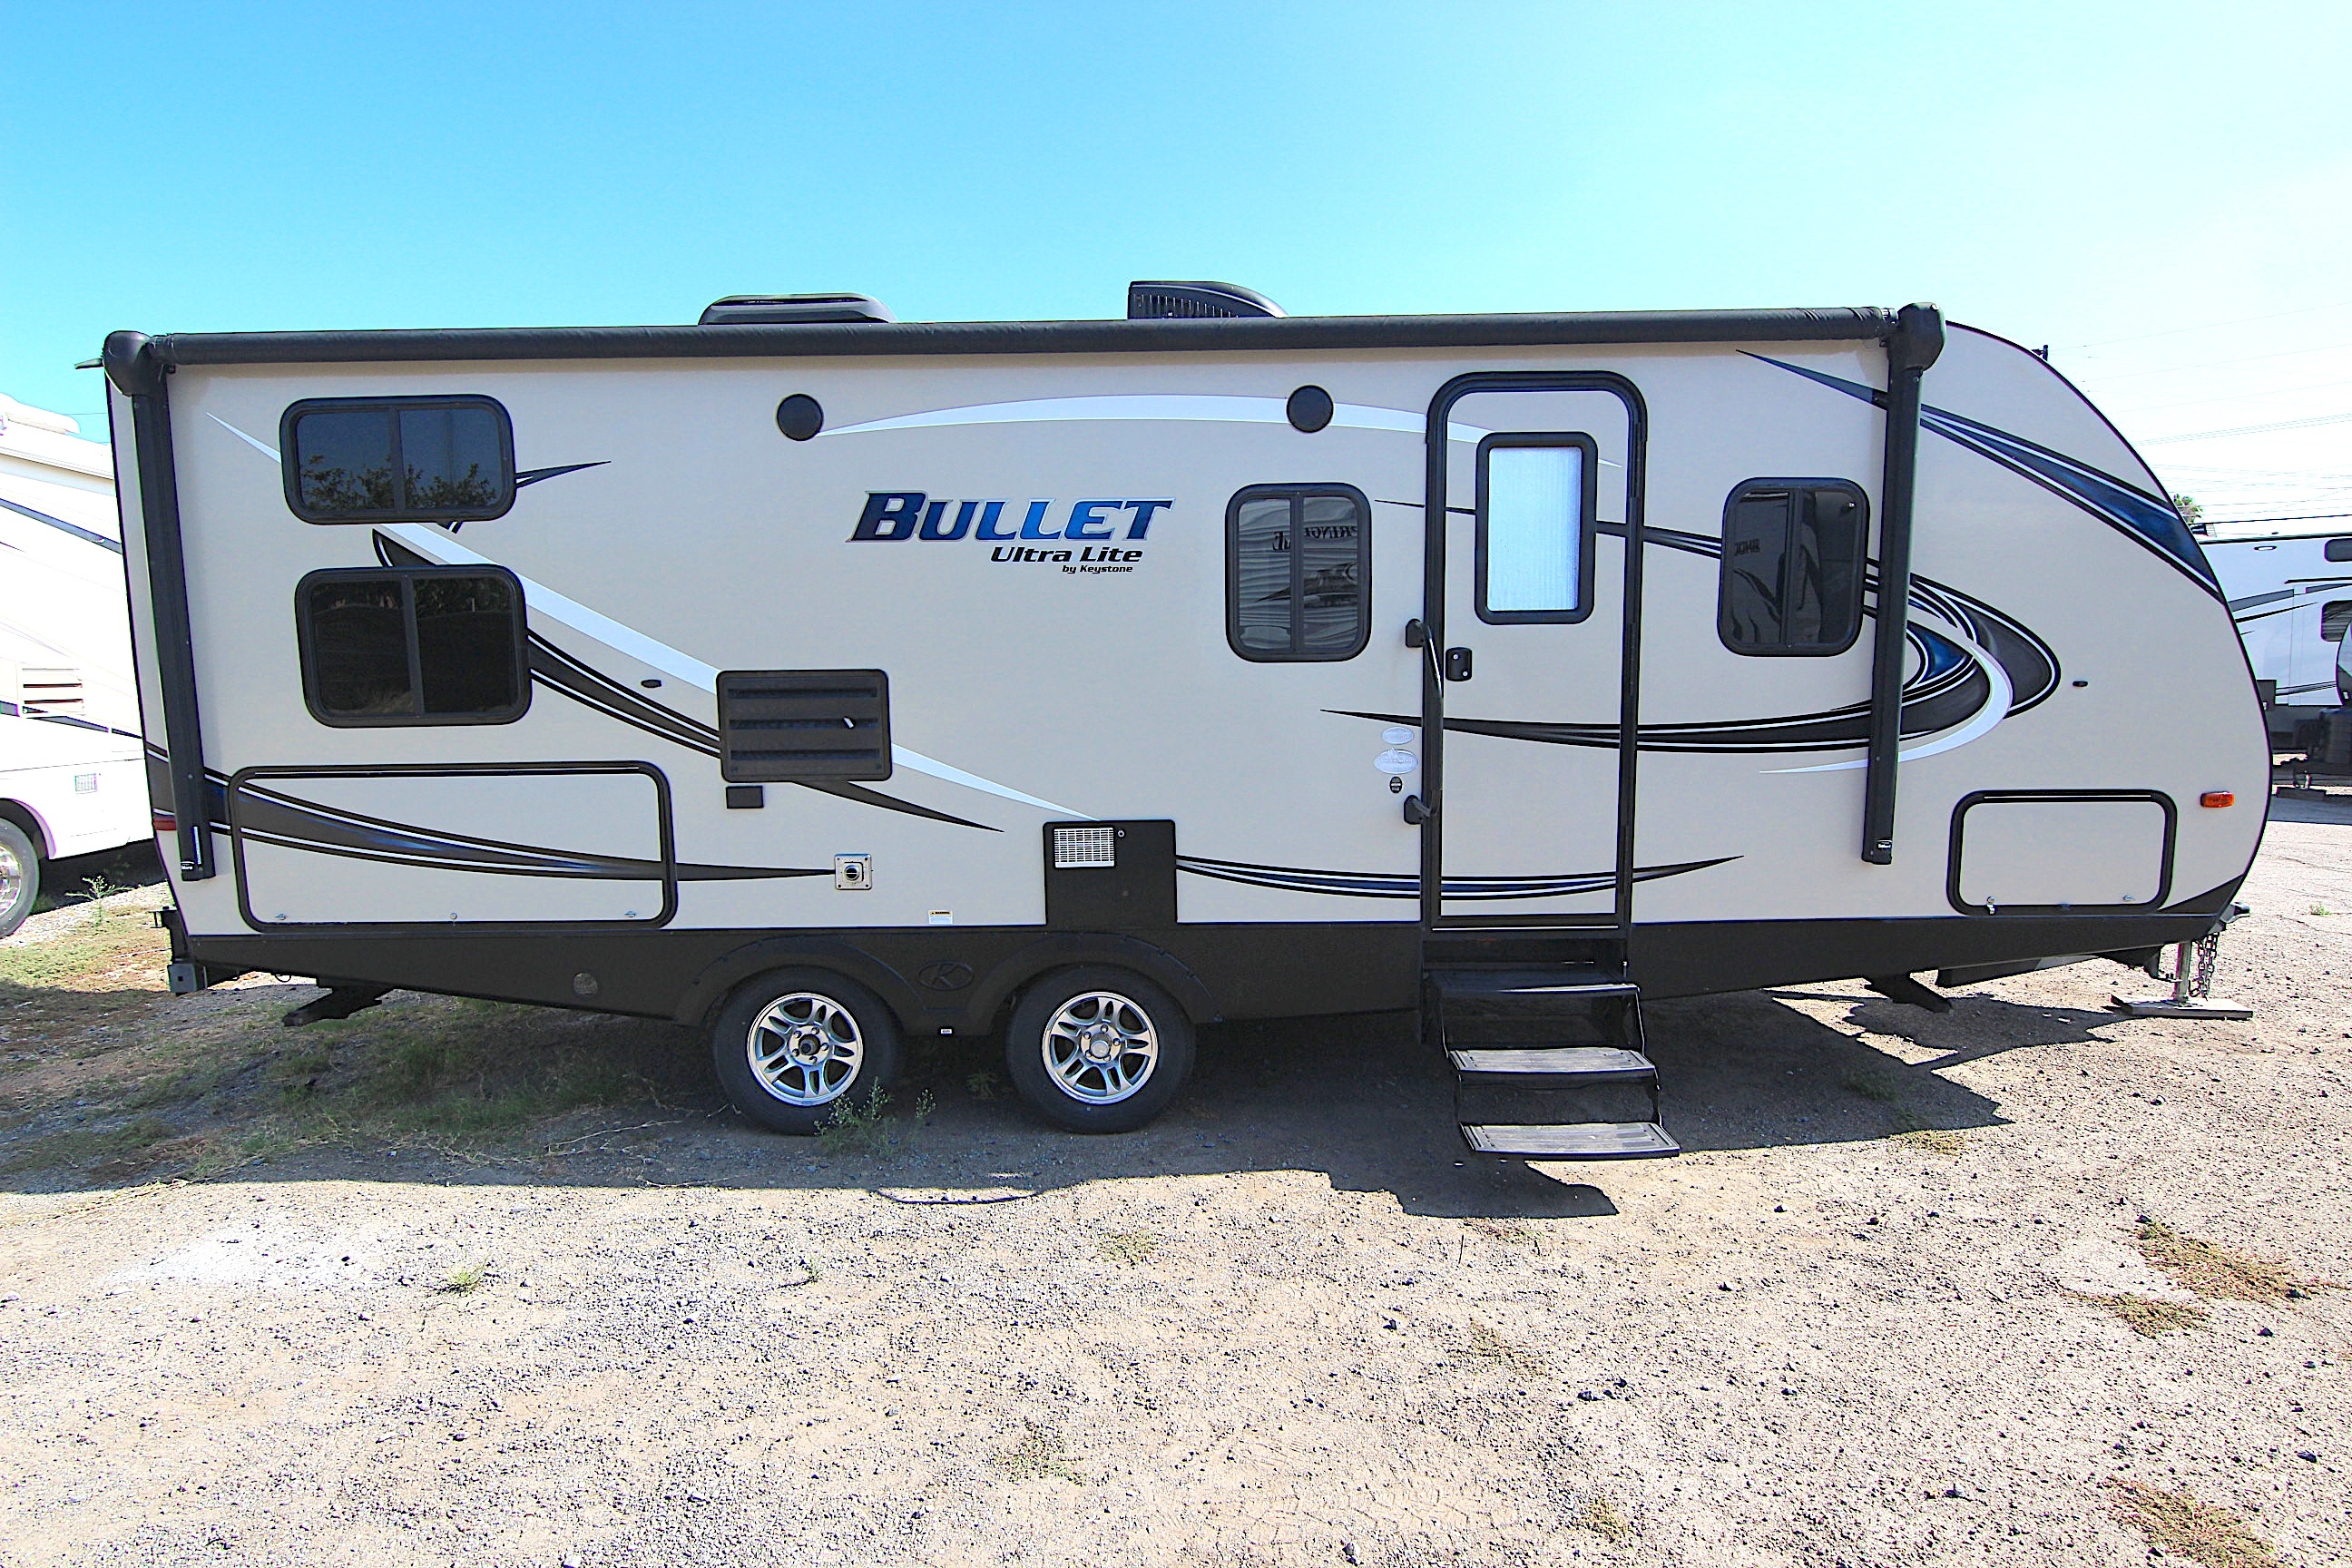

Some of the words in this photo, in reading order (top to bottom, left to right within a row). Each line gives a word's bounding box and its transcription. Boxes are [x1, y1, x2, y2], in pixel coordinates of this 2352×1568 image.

[847, 491, 1175, 543] BULLET
[990, 546, 1073, 563] Ultra
[1079, 546, 1143, 563] Lite
[1062, 564, 1077, 574] by
[1079, 564, 1133, 574] Keystone
